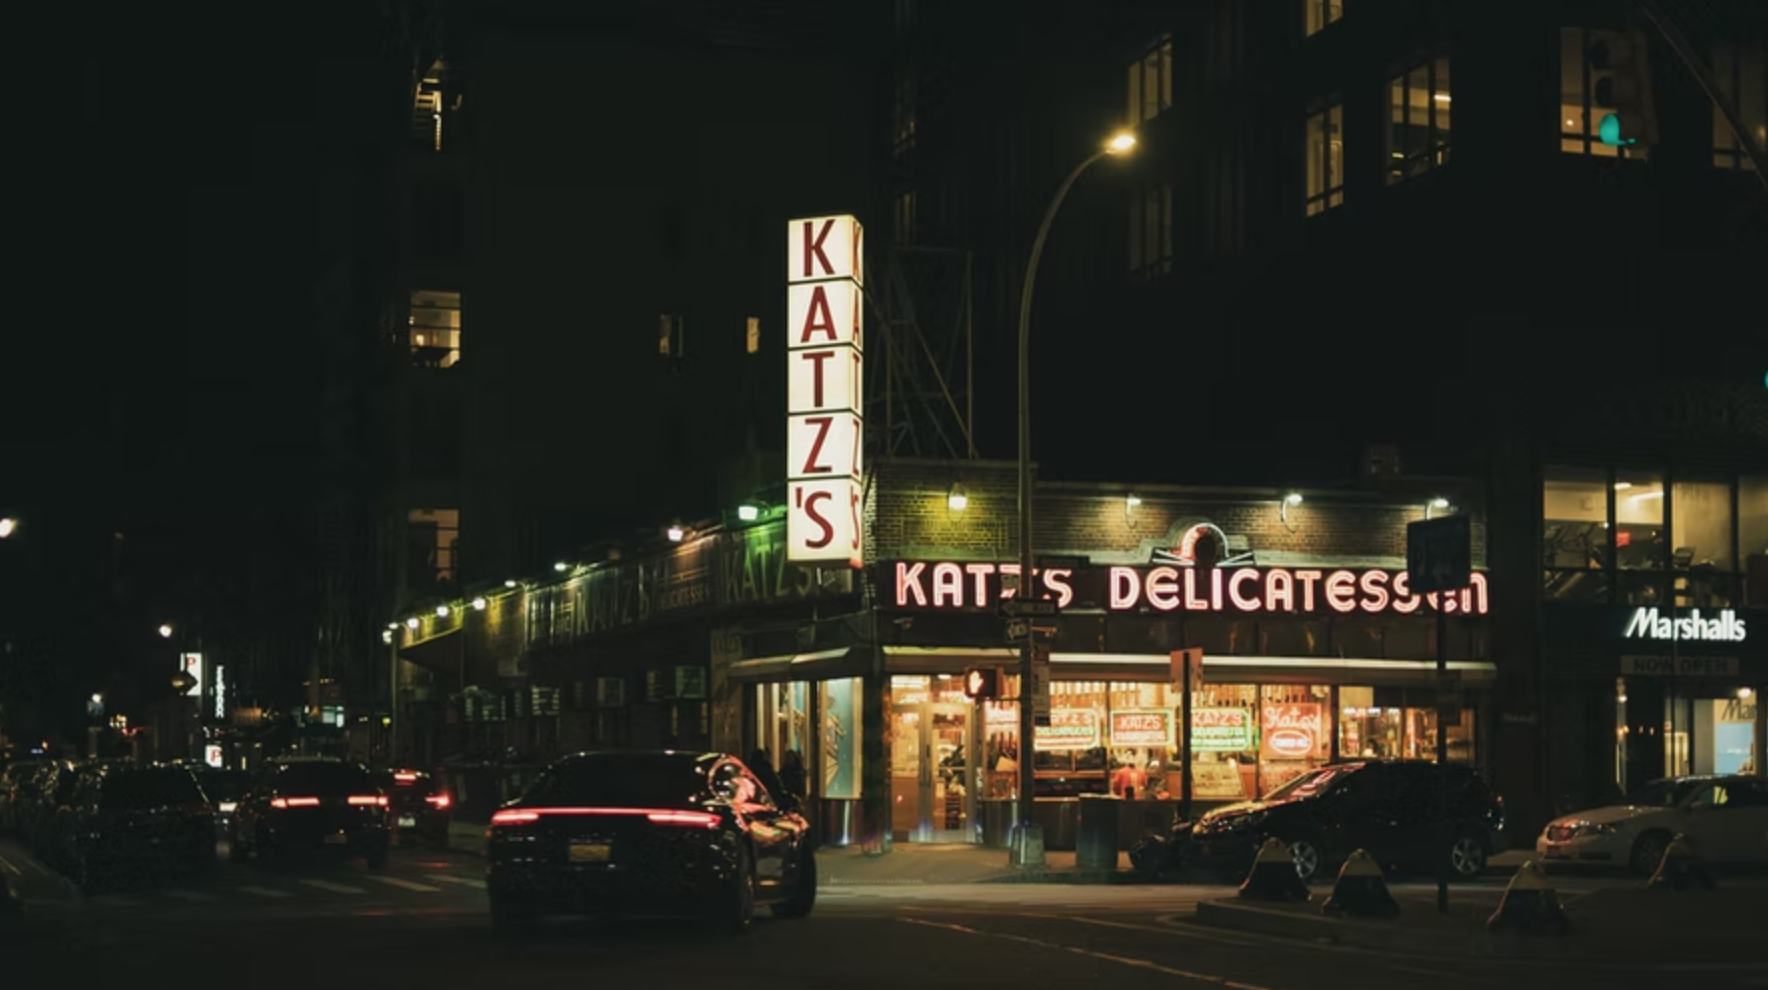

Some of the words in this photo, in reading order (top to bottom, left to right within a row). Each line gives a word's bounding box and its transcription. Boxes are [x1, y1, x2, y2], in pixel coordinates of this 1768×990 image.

[795, 218, 838, 549] KATZ'S
[724, 542, 812, 603] KATZS
[1623, 606, 1746, 641] Marshalls
